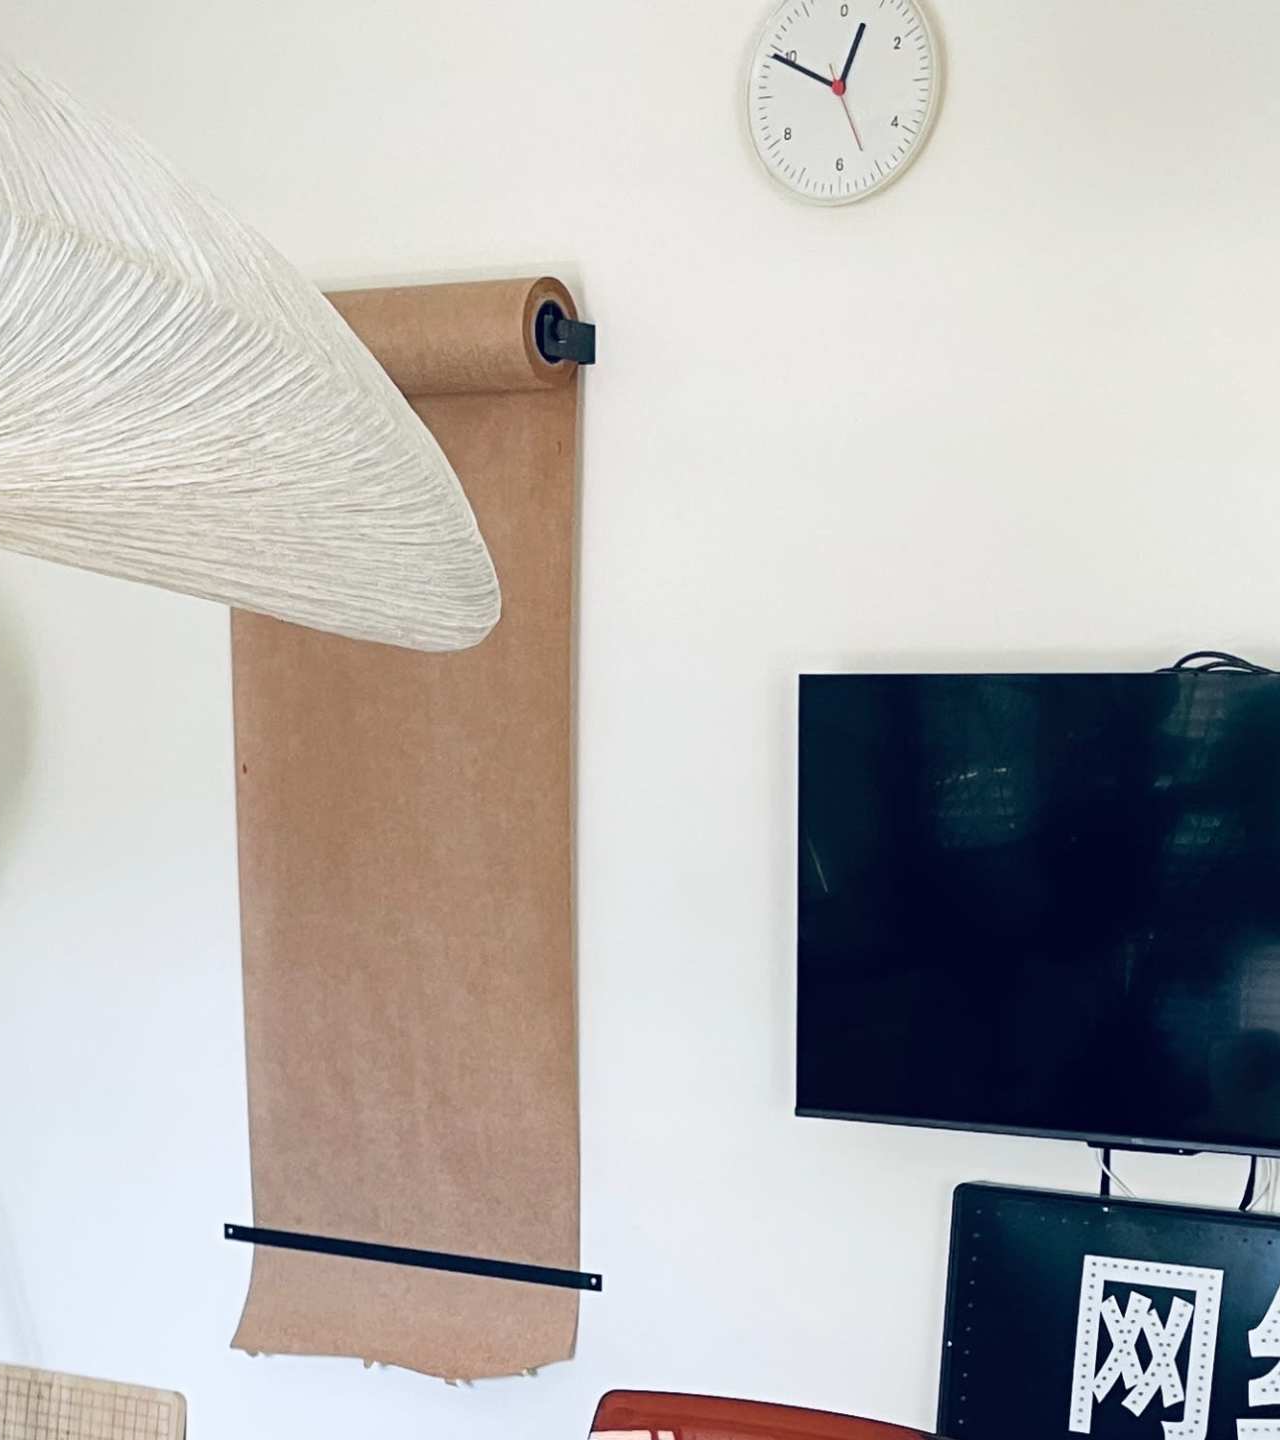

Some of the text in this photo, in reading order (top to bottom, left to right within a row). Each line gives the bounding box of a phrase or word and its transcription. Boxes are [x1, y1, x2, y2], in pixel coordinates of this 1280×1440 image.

[893, 36, 902, 50] 2
[890, 115, 900, 129] 4
[783, 127, 792, 141] 8
[835, 157, 845, 172] 6
